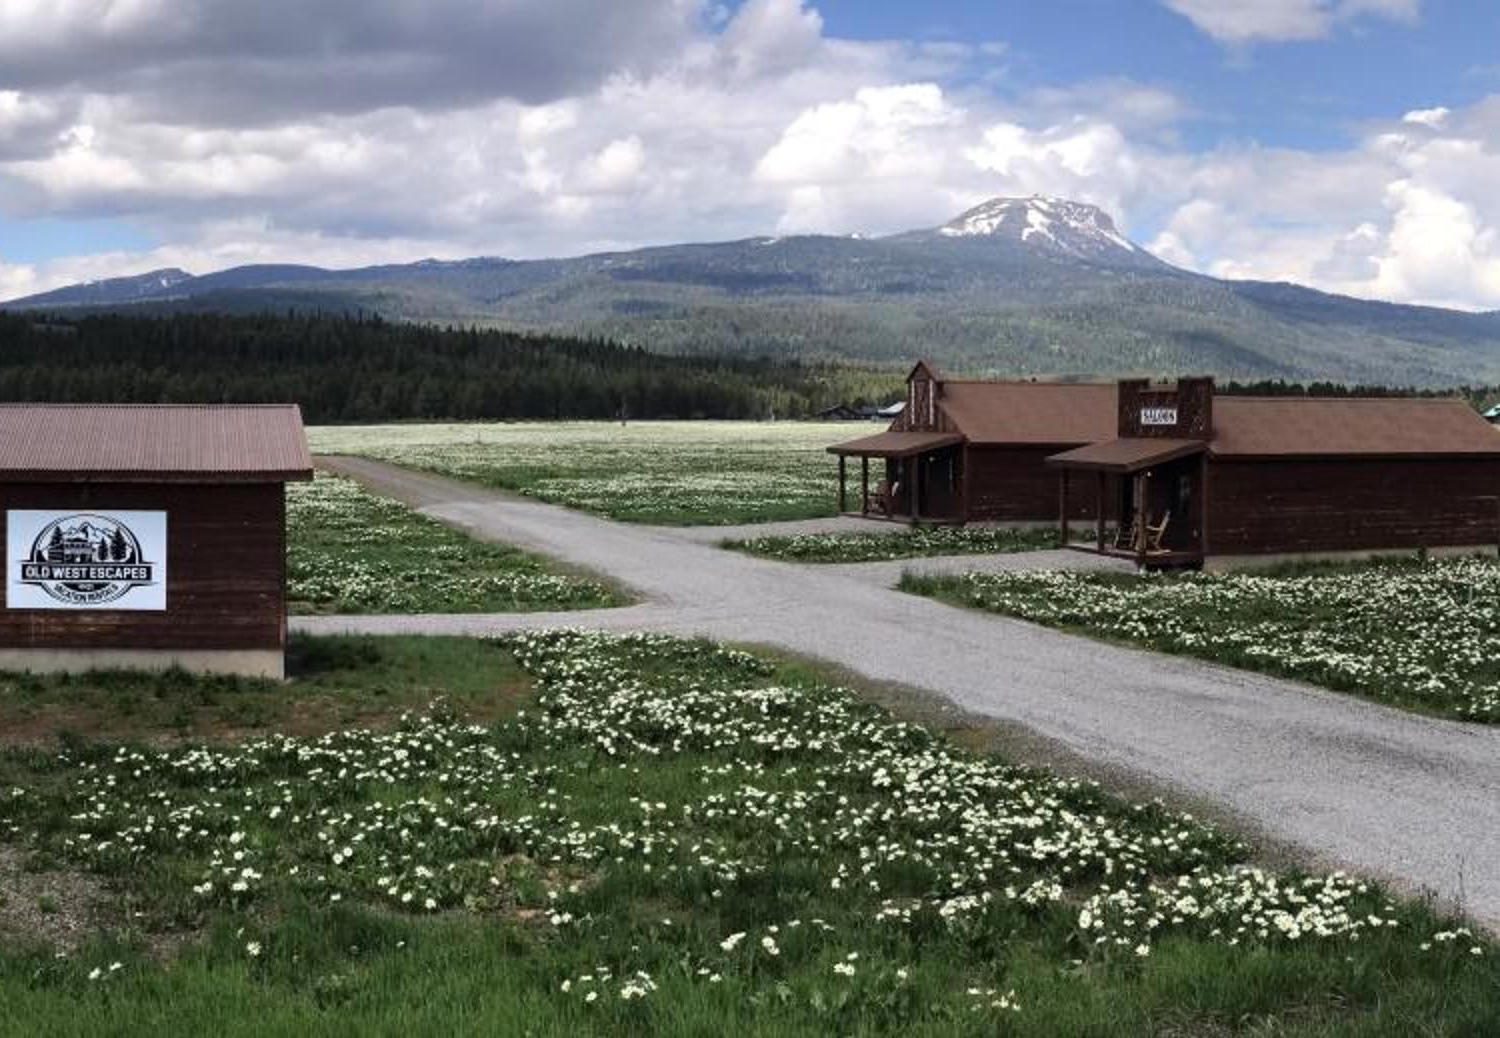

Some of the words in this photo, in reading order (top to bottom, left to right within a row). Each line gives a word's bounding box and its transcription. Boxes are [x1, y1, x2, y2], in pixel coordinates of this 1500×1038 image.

[25, 567, 51, 579] OLD
[52, 567, 88, 579] WEST
[89, 567, 147, 579] ESCAPES
